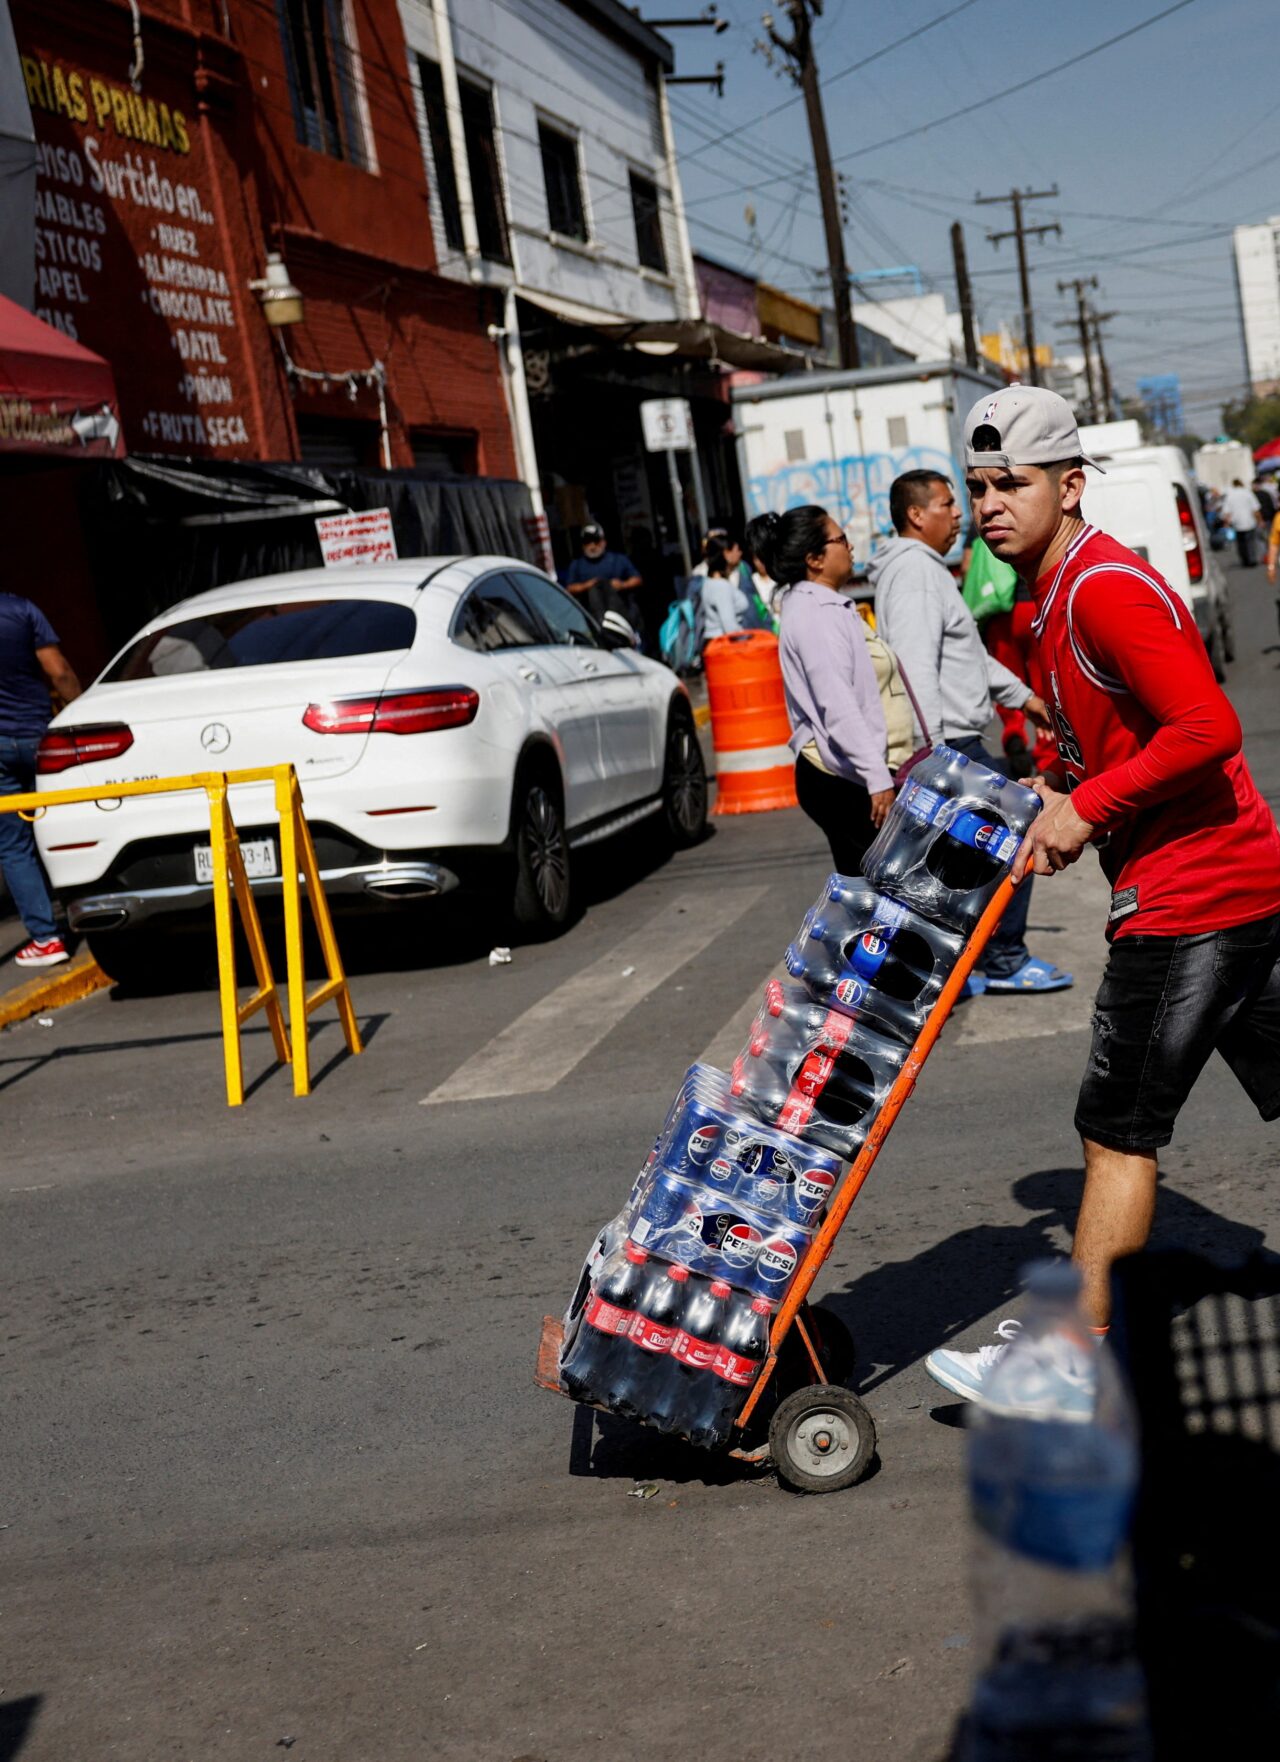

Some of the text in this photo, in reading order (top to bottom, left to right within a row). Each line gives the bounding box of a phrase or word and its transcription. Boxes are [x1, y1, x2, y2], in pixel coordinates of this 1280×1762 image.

[89, 77, 190, 154] PRIMAS
[84, 134, 174, 214] Surtido
[36, 264, 88, 303] APEL
[145, 252, 230, 297] ALMENDRA
[149, 285, 235, 328] CHOCOLATE
[175, 327, 228, 364] DATIL
[147, 410, 249, 447] FRUTA SECA
[843, 981, 857, 1003] PEPSI
[711, 1164, 730, 1176] PEPSI
[724, 1234, 759, 1256] PEPSI
[761, 1249, 793, 1271] PEPSI
